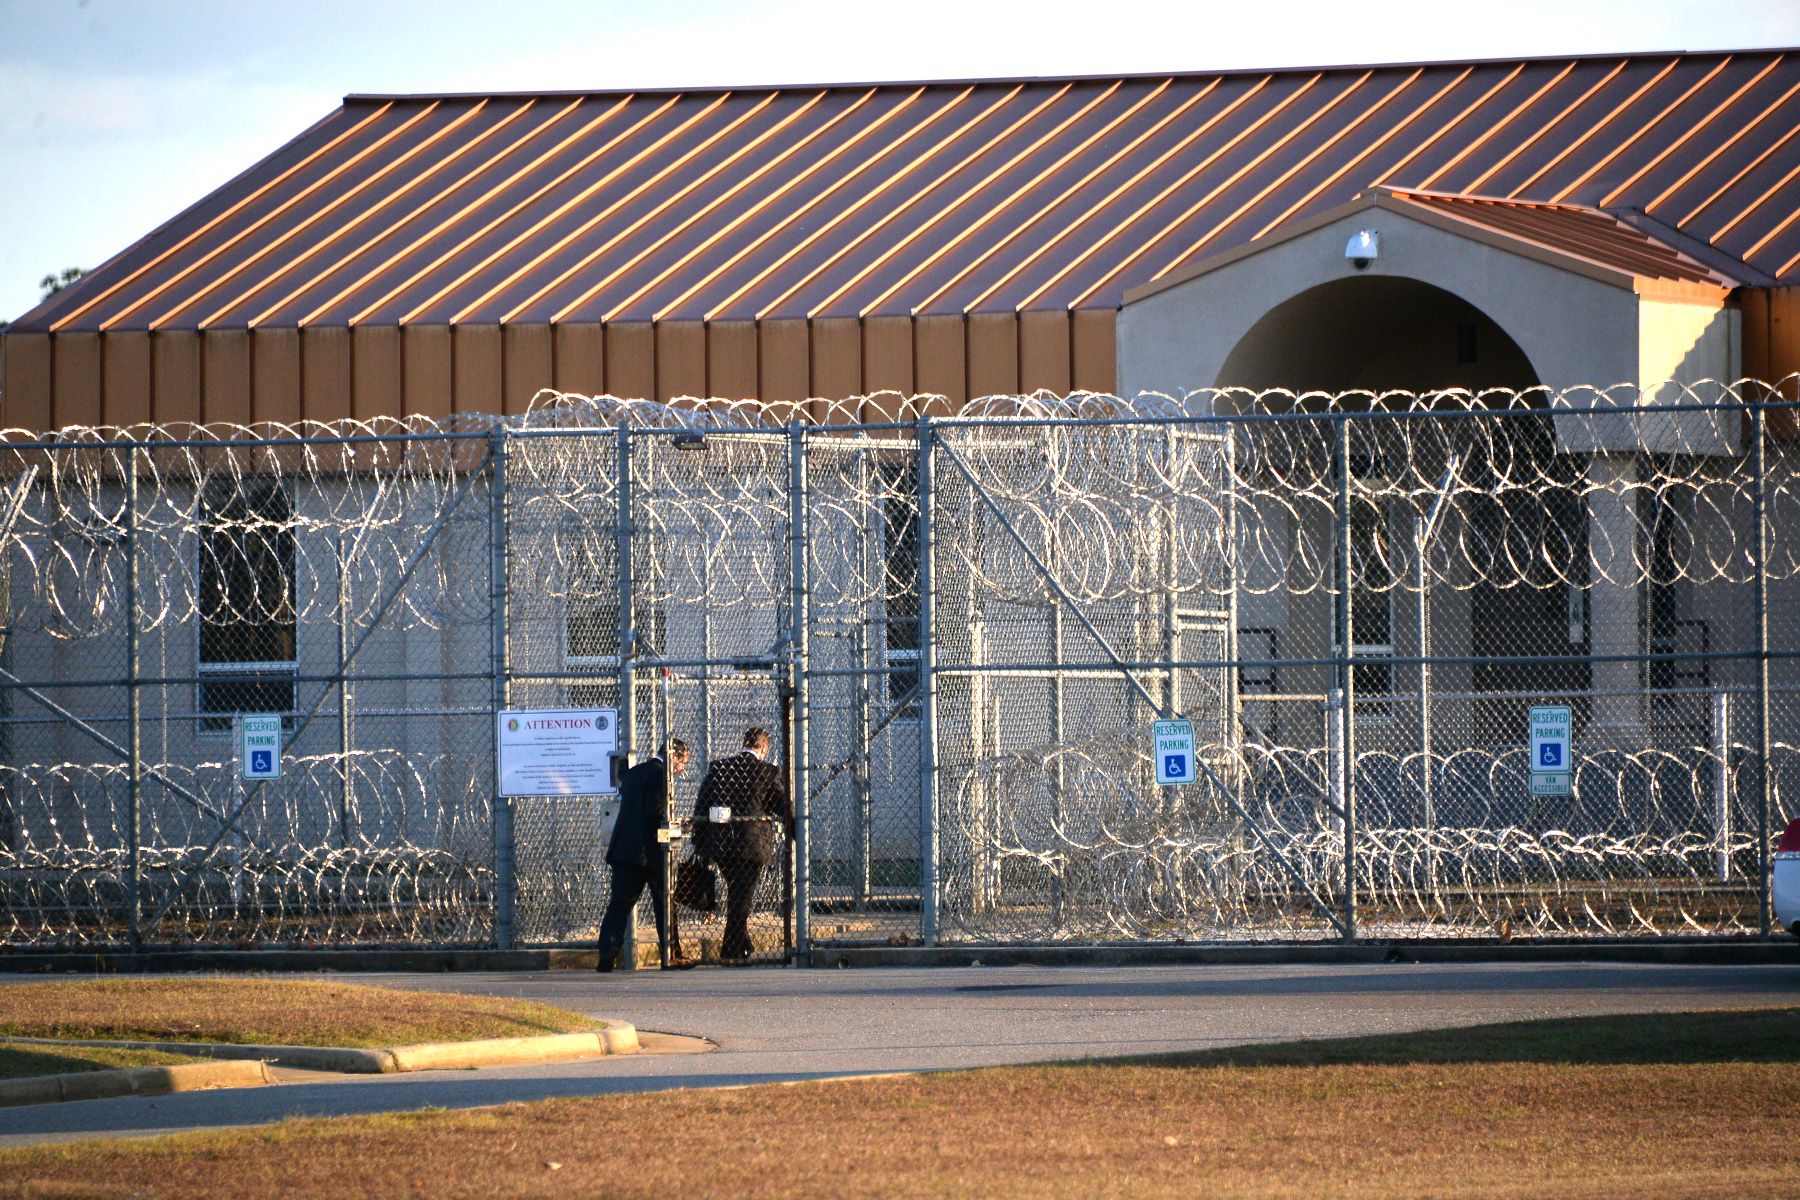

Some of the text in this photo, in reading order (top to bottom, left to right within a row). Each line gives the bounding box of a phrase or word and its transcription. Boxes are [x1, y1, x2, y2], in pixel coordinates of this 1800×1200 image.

[1533, 713, 1568, 724] RESERVED
[245, 721, 278, 731] RESERVED
[524, 719, 592, 730] ATTENTION
[1156, 725, 1191, 736] RESERVED
[1535, 728, 1565, 738] PARKING
[247, 736, 276, 746] PARKING
[1160, 740, 1190, 750] PARKING
[1533, 784, 1568, 793] ACCESSIBLE
